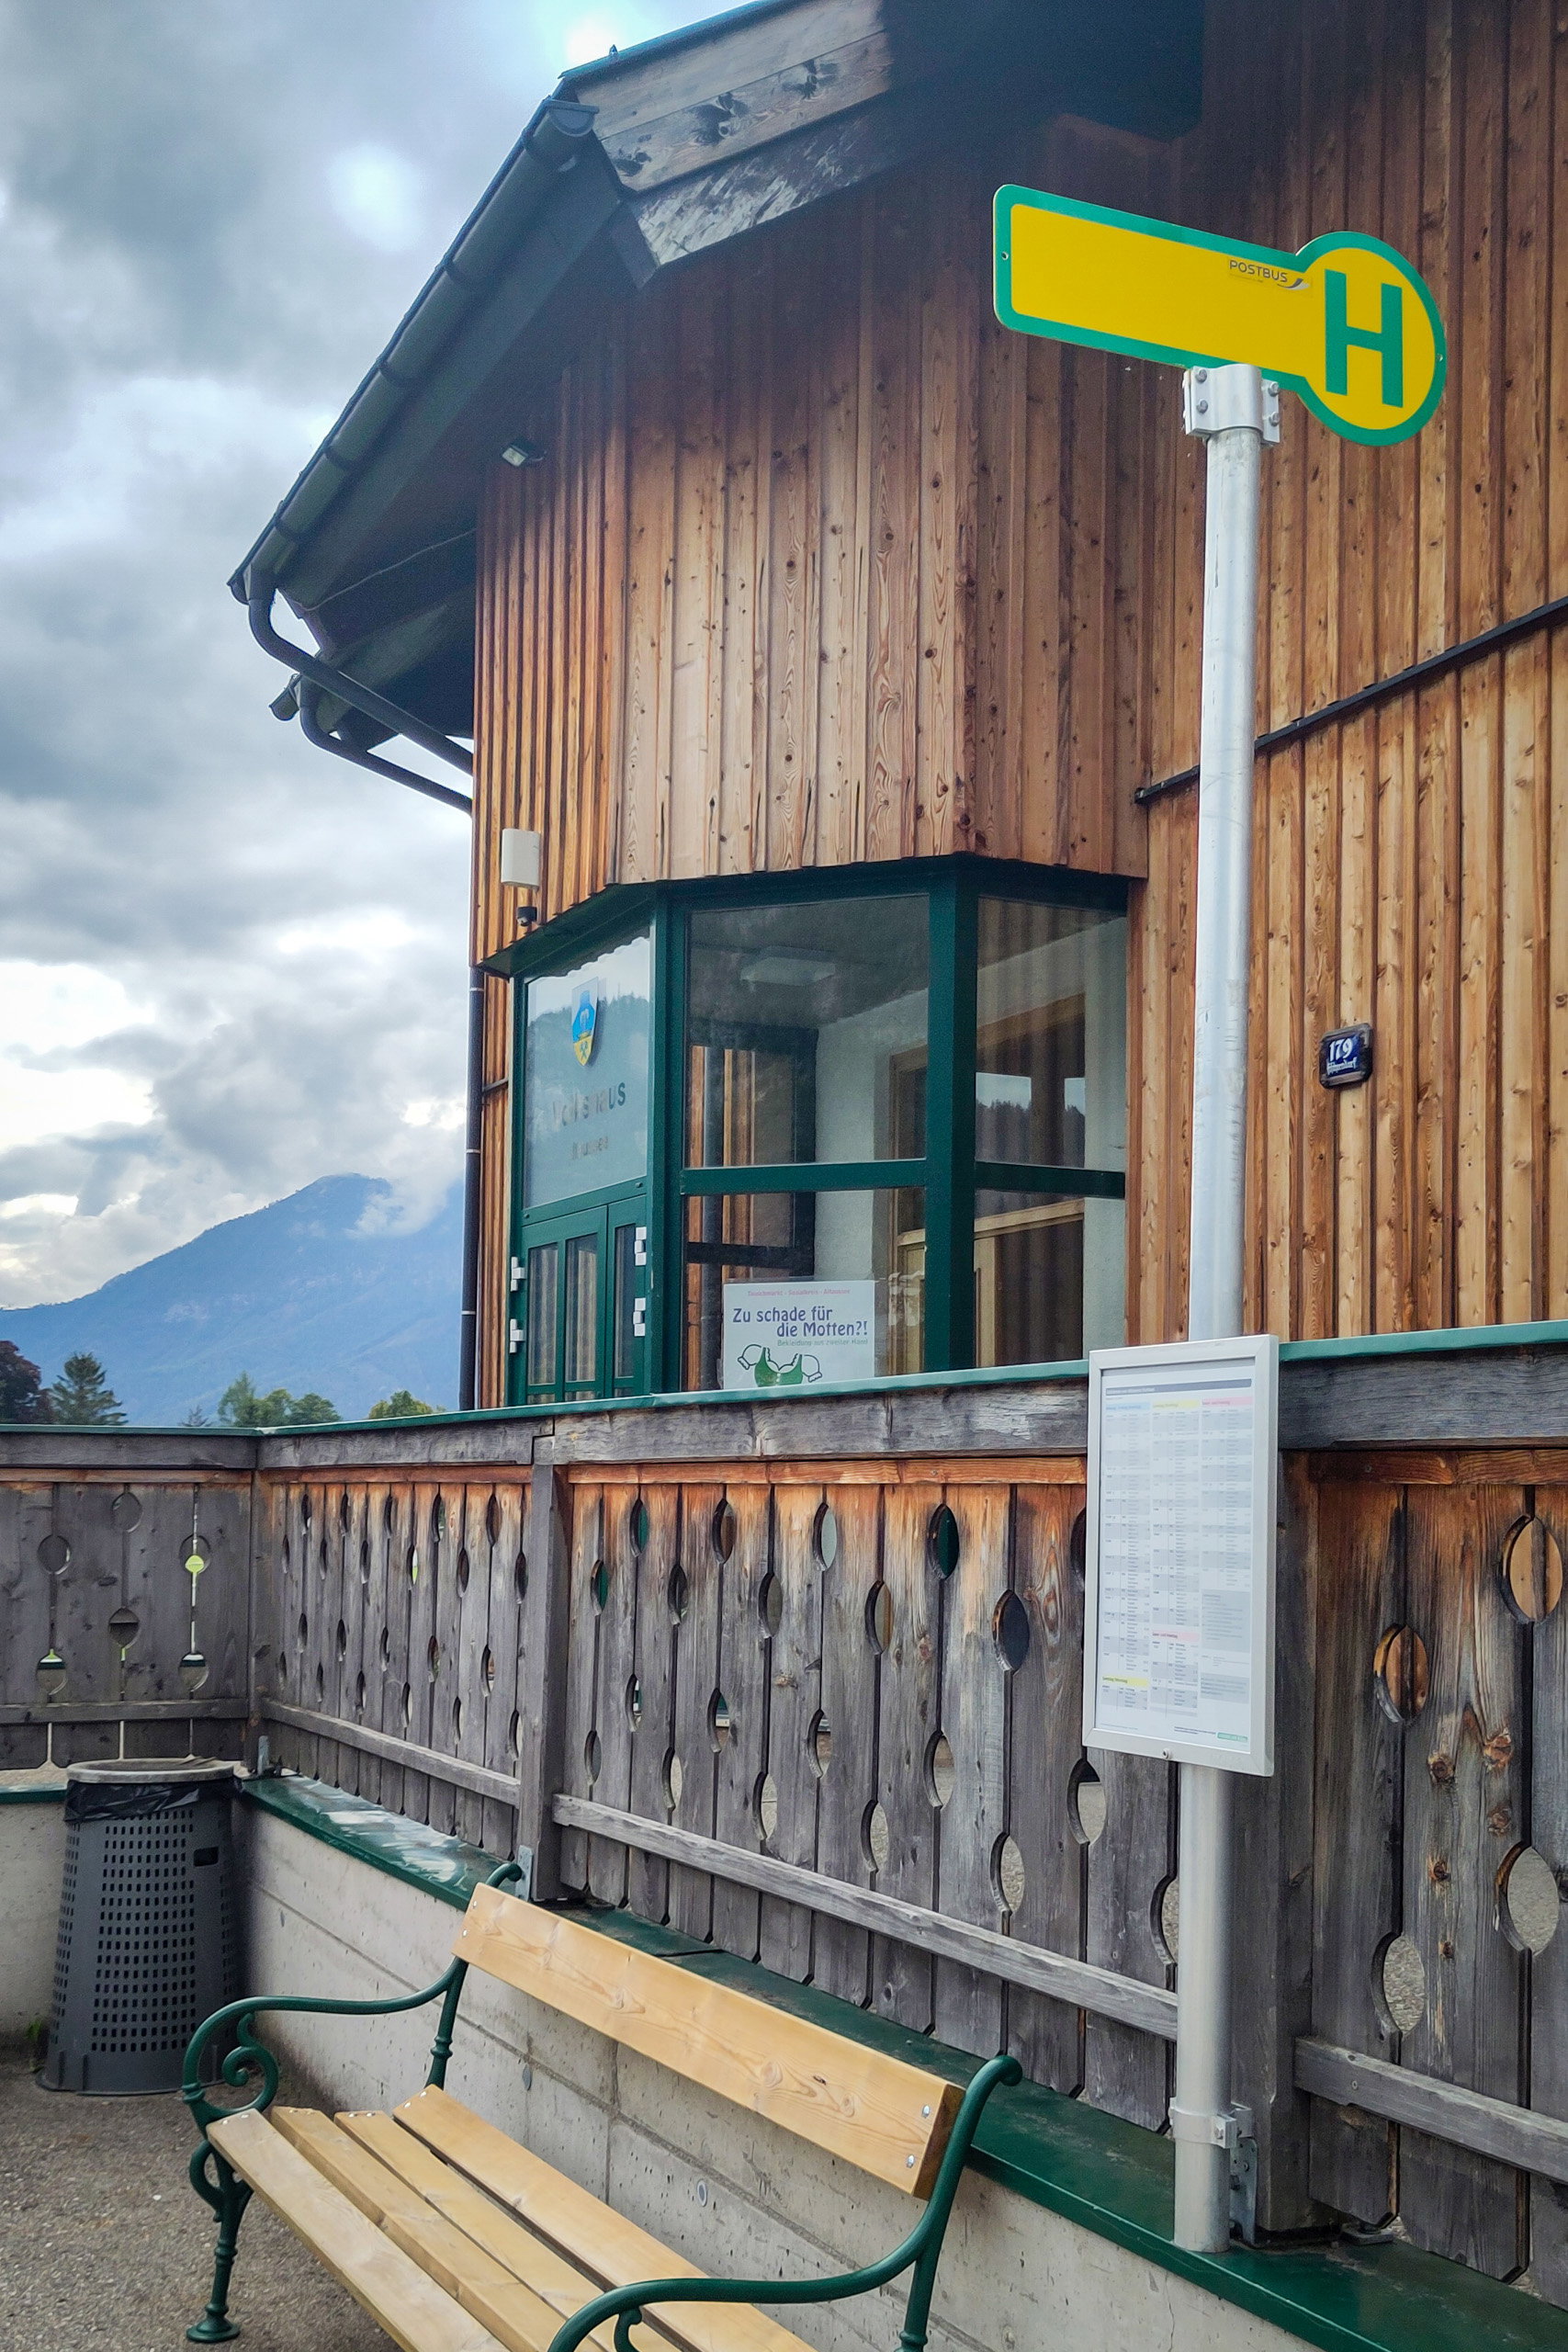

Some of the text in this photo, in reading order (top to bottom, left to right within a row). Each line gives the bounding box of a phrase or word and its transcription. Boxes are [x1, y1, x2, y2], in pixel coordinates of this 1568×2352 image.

[1229, 260, 1288, 282] POSTBUS
[1325, 268, 1404, 408] H
[1329, 1037, 1353, 1061] 179
[733, 1306, 832, 1323] Zu schade für
[776, 1320, 868, 1337] die Motten?!
